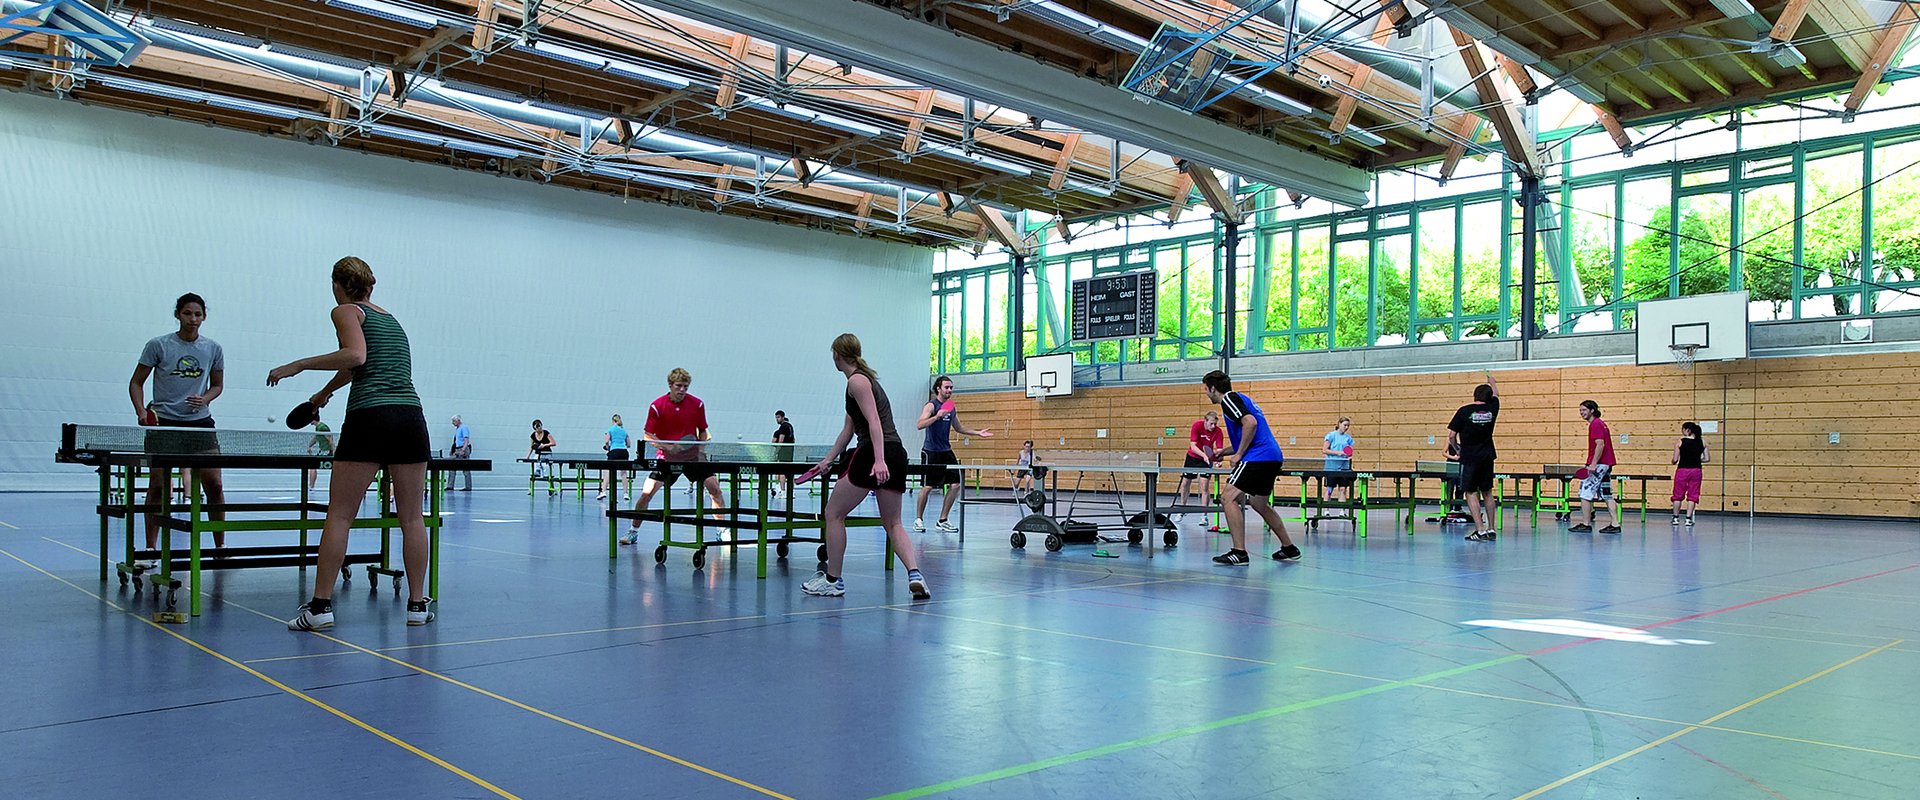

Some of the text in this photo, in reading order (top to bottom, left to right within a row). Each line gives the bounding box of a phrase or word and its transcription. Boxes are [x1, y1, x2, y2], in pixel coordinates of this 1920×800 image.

[1106, 278, 1127, 291] 9:53
[1119, 290, 1136, 299] GAST
[739, 466, 758, 474] JOOLA
